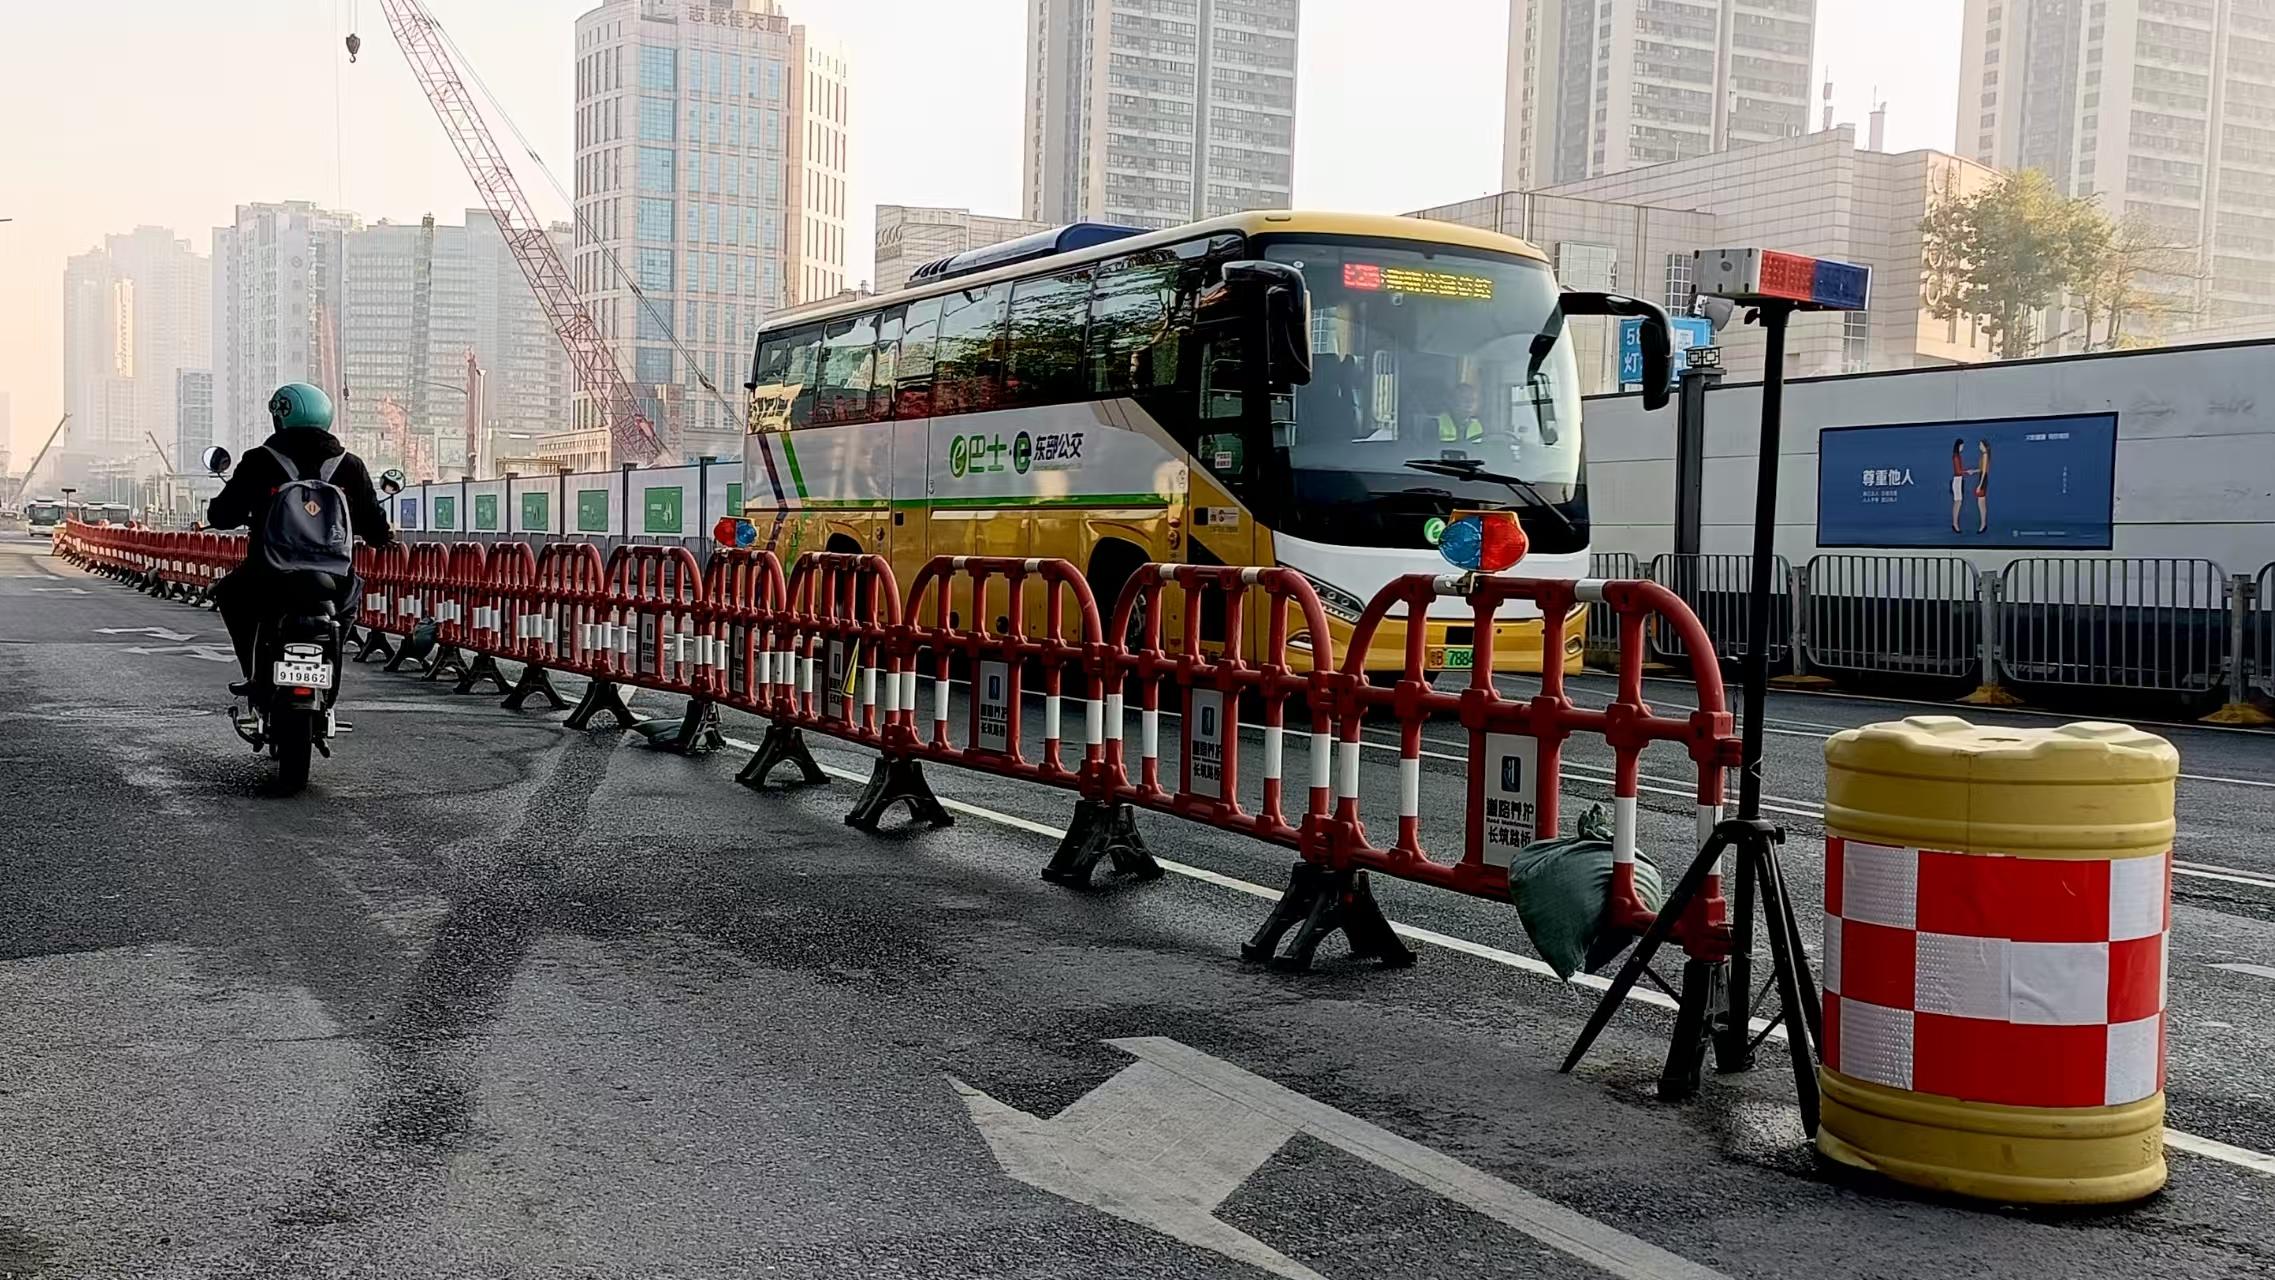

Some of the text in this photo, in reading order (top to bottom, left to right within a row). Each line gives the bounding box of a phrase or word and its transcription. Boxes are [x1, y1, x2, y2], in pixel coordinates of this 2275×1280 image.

[1034, 432, 1084, 461] 东部公交
[1863, 469, 1914, 486] 尊重他人
[280, 671, 325, 683] 919862
